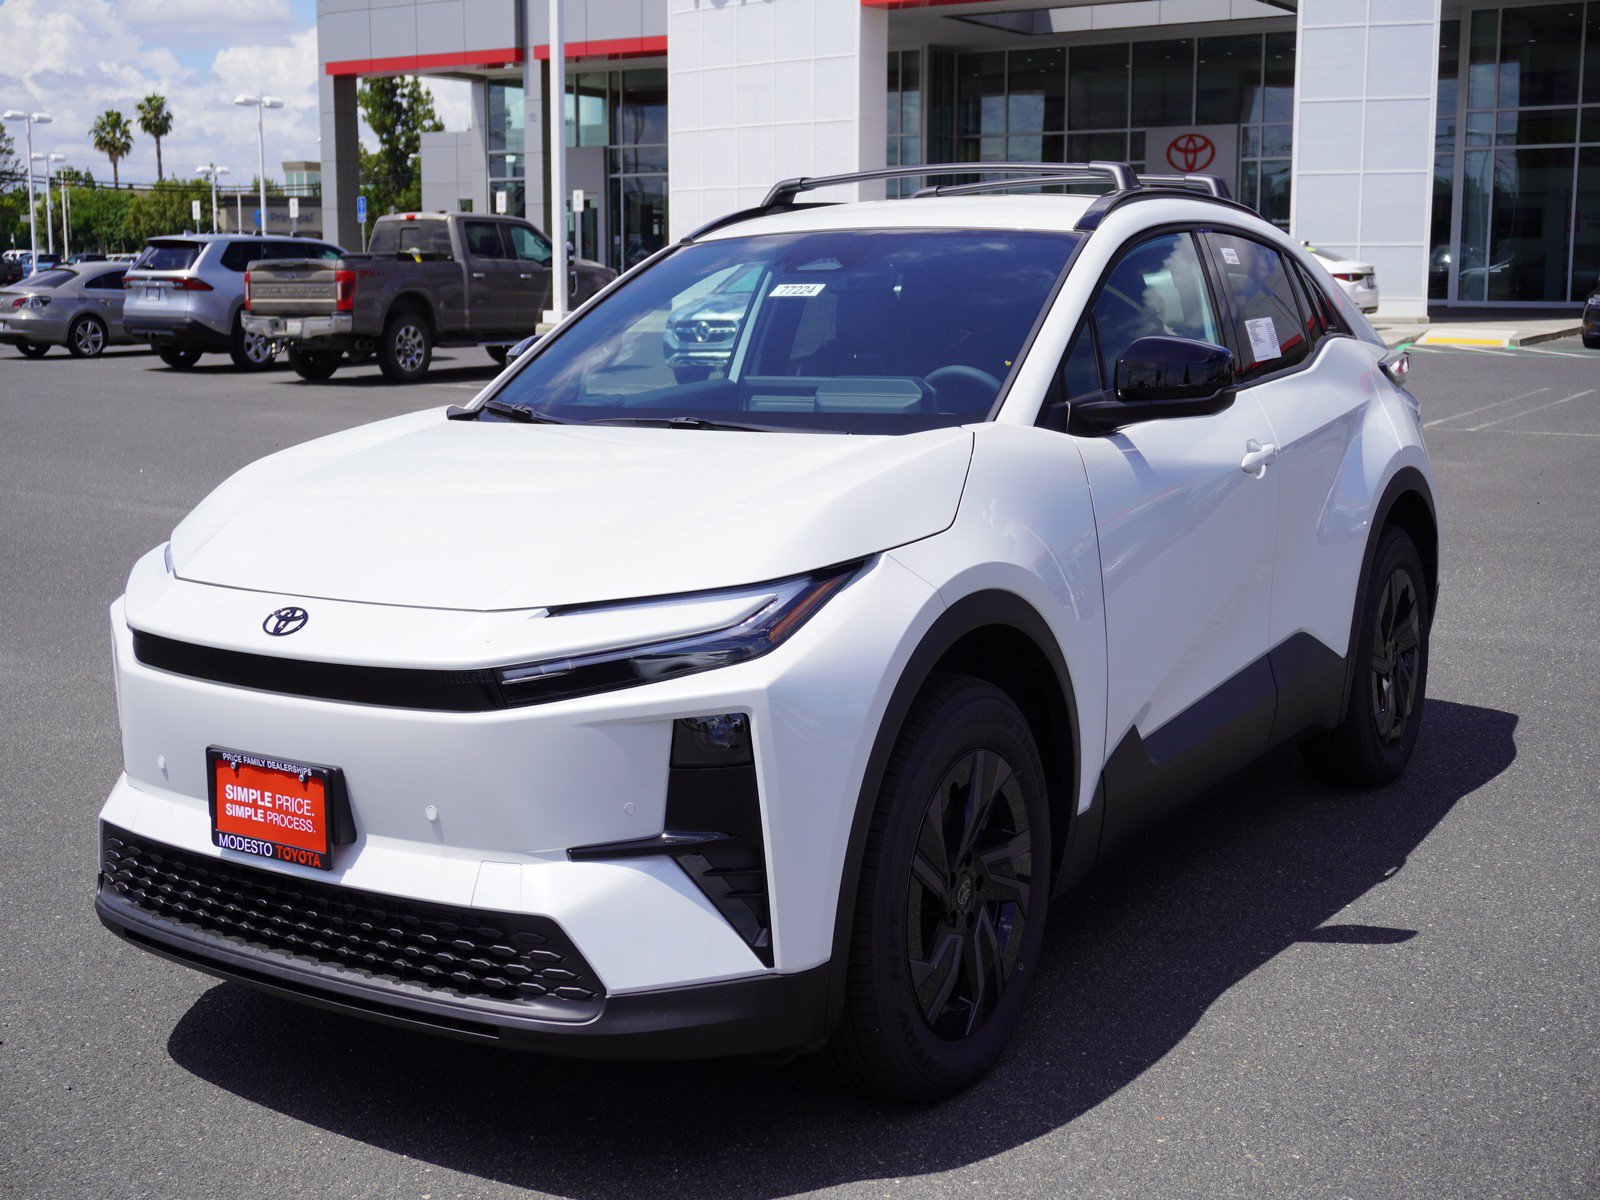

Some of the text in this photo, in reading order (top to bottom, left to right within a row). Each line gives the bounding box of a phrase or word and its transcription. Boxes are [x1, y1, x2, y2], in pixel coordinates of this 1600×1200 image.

[779, 286, 817, 294] 77224
[222, 753, 312, 776] PRICE FAMILY DEALERSHIPS
[225, 784, 315, 817] SIMPLE PRICE.
[225, 803, 316, 833] SIMPLE PROCESS.
[218, 833, 321, 867] MODESTO TOYOTA
